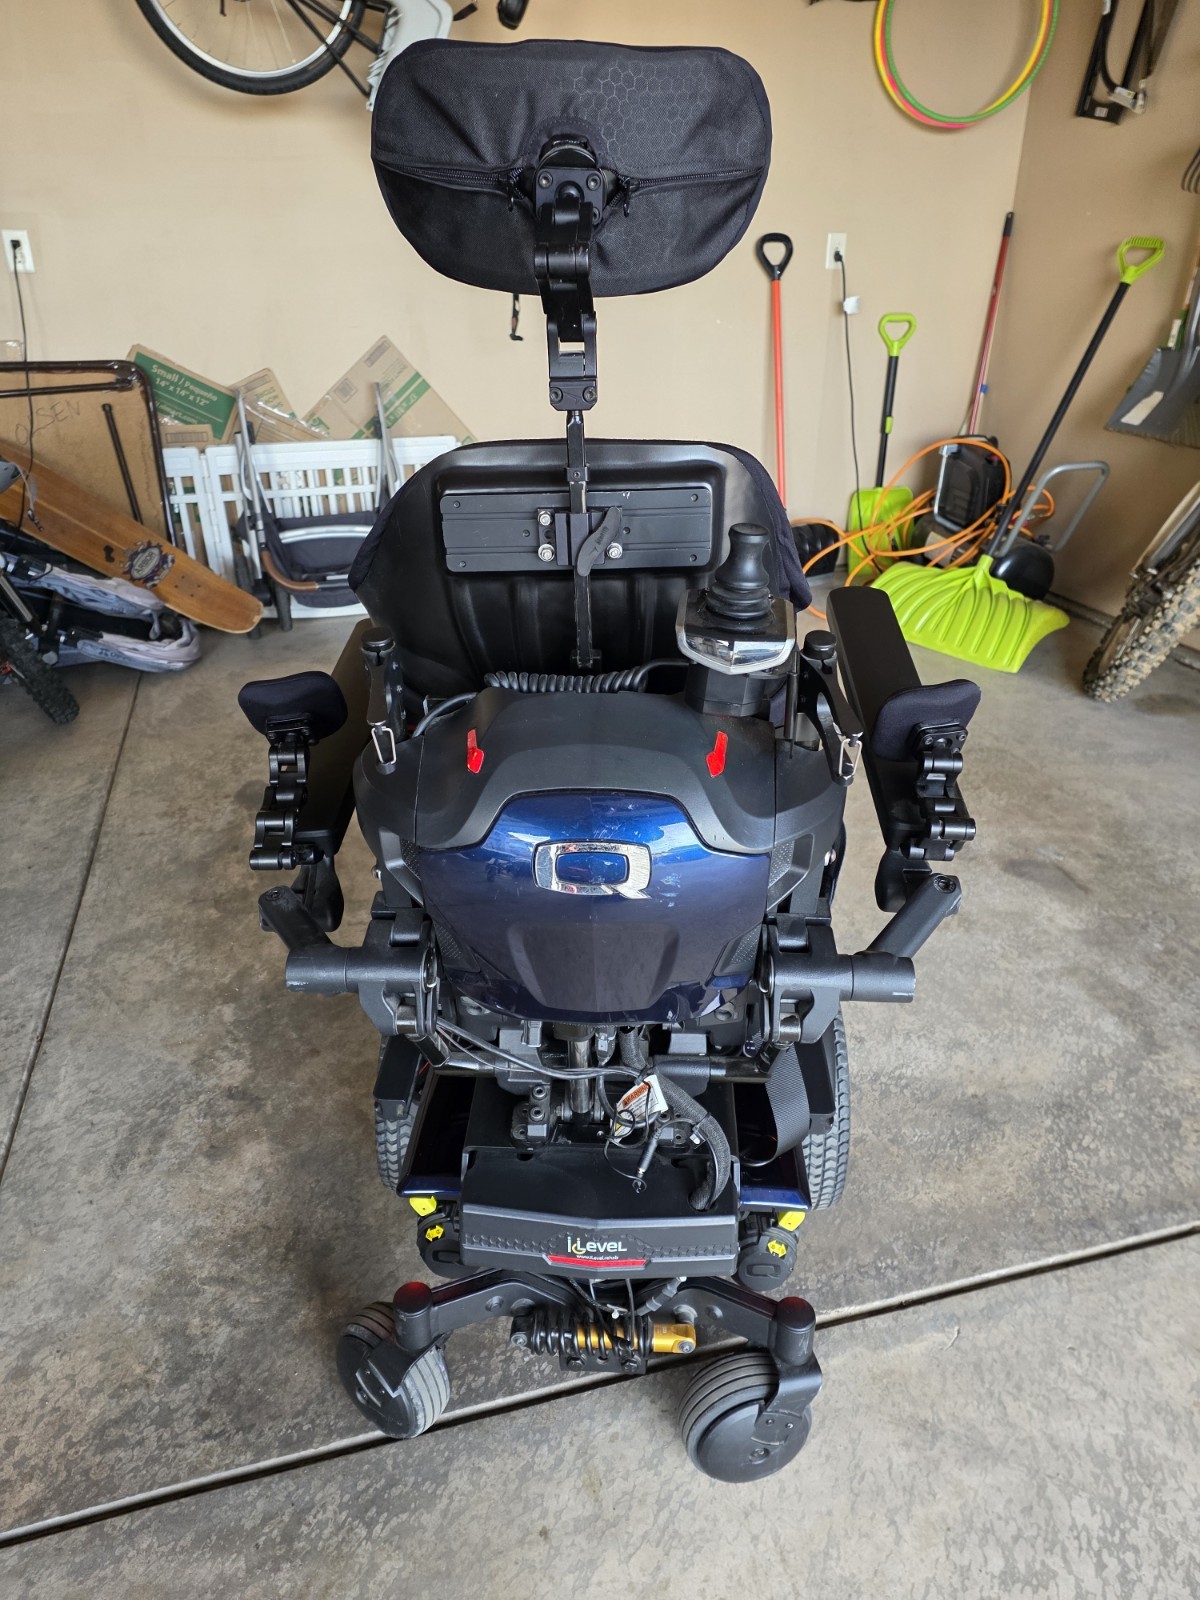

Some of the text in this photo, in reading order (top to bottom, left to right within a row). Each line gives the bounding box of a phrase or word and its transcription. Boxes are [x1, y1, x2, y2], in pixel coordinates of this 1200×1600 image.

[151, 364, 179, 383] Small
[15, 400, 81, 446] OSEN
[134, 551, 155, 574] ARBOR
